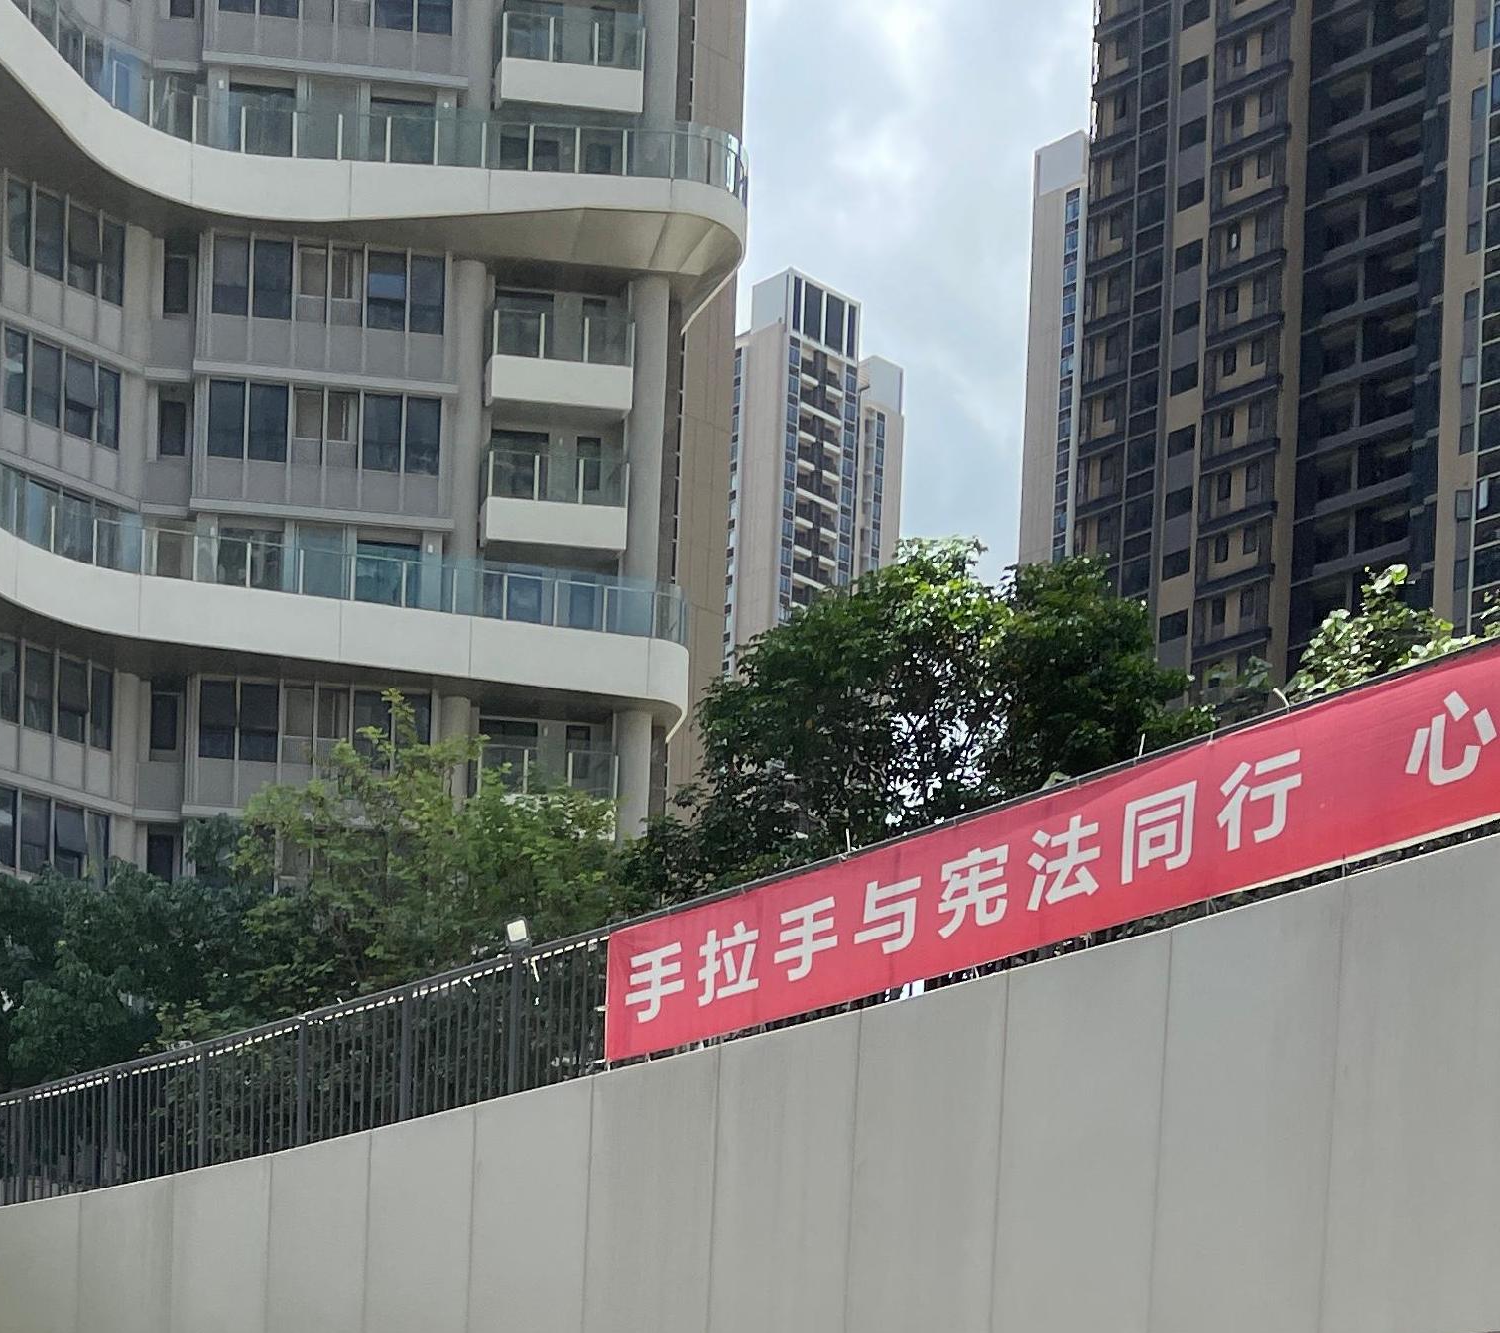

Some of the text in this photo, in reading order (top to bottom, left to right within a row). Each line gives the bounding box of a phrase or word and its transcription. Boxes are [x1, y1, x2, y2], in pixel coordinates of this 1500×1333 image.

[624, 690, 1497, 1024] 手拉手与宪法同行 心
